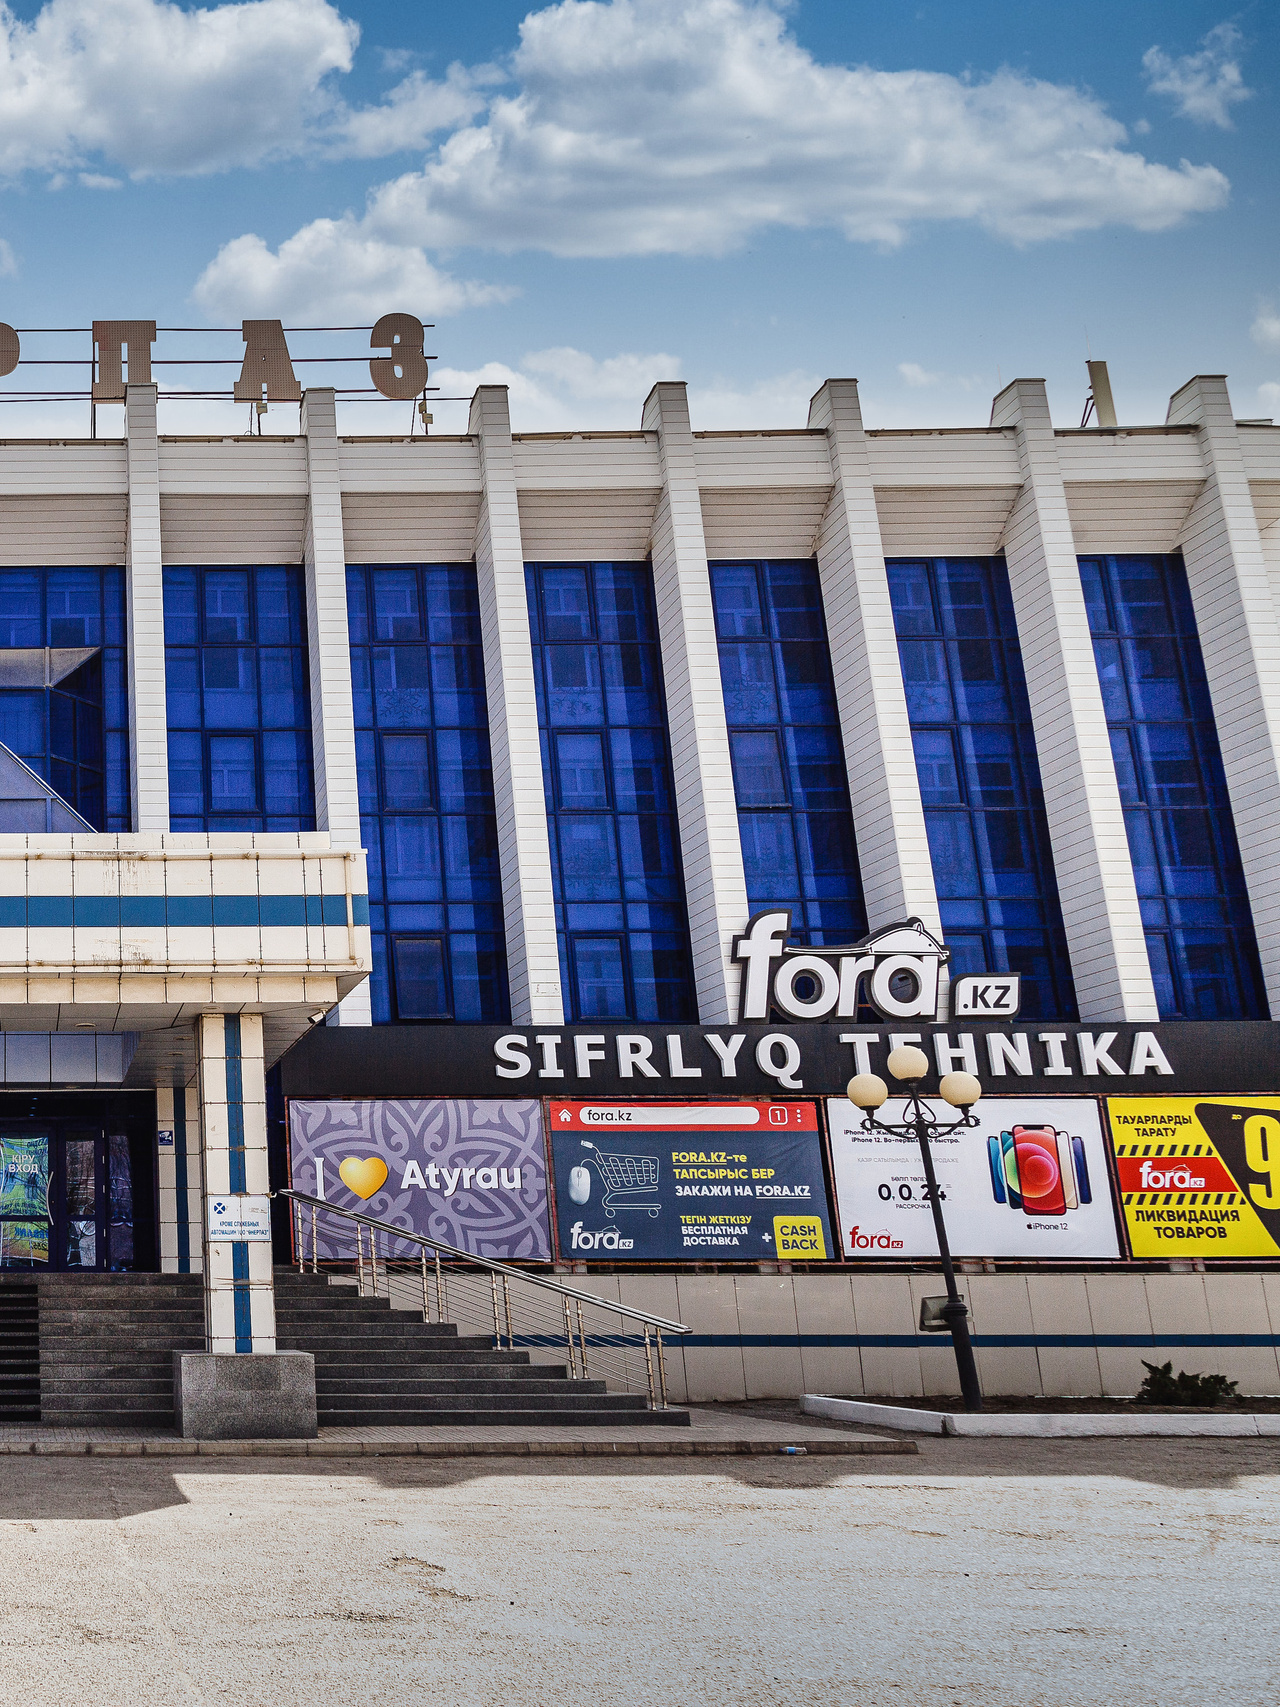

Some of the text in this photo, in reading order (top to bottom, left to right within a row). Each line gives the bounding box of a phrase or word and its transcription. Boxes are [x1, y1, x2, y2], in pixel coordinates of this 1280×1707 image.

[493, 1032, 804, 1090] SIFRLYQ
[587, 1109, 633, 1122] fora.kz
[1115, 1115, 1192, 1125] ТАУАРЛАРДЫ
[1134, 1127, 1177, 1137] ТАРАТУ
[934, 1137, 961, 1145] быстро.
[12, 1154, 36, 1164] КІРУ
[672, 1152, 748, 1163] FORA.KZ-те
[8, 1163, 39, 1174] ВХОД
[673, 1168, 775, 1179] ТАПСЫРЫС БЕР
[400, 1159, 523, 1197] Atyrau
[675, 1185, 812, 1197] ЗАКАЖИ НА FORA.KZ
[680, 1215, 752, 1224] ТЕГІН ЖЕТКІЗУ
[1135, 1209, 1241, 1223] ЛИКВИДАЦИЯ
[681, 1226, 749, 1235] БЕСПЛАТНАЯ
[780, 1225, 817, 1237] CASH
[1033, 1222, 1069, 1231] iPhone 12
[1153, 1226, 1228, 1239] ТОВАРОВ
[683, 1236, 740, 1247] ДОСТАВКА
[781, 1239, 820, 1250] BACK
